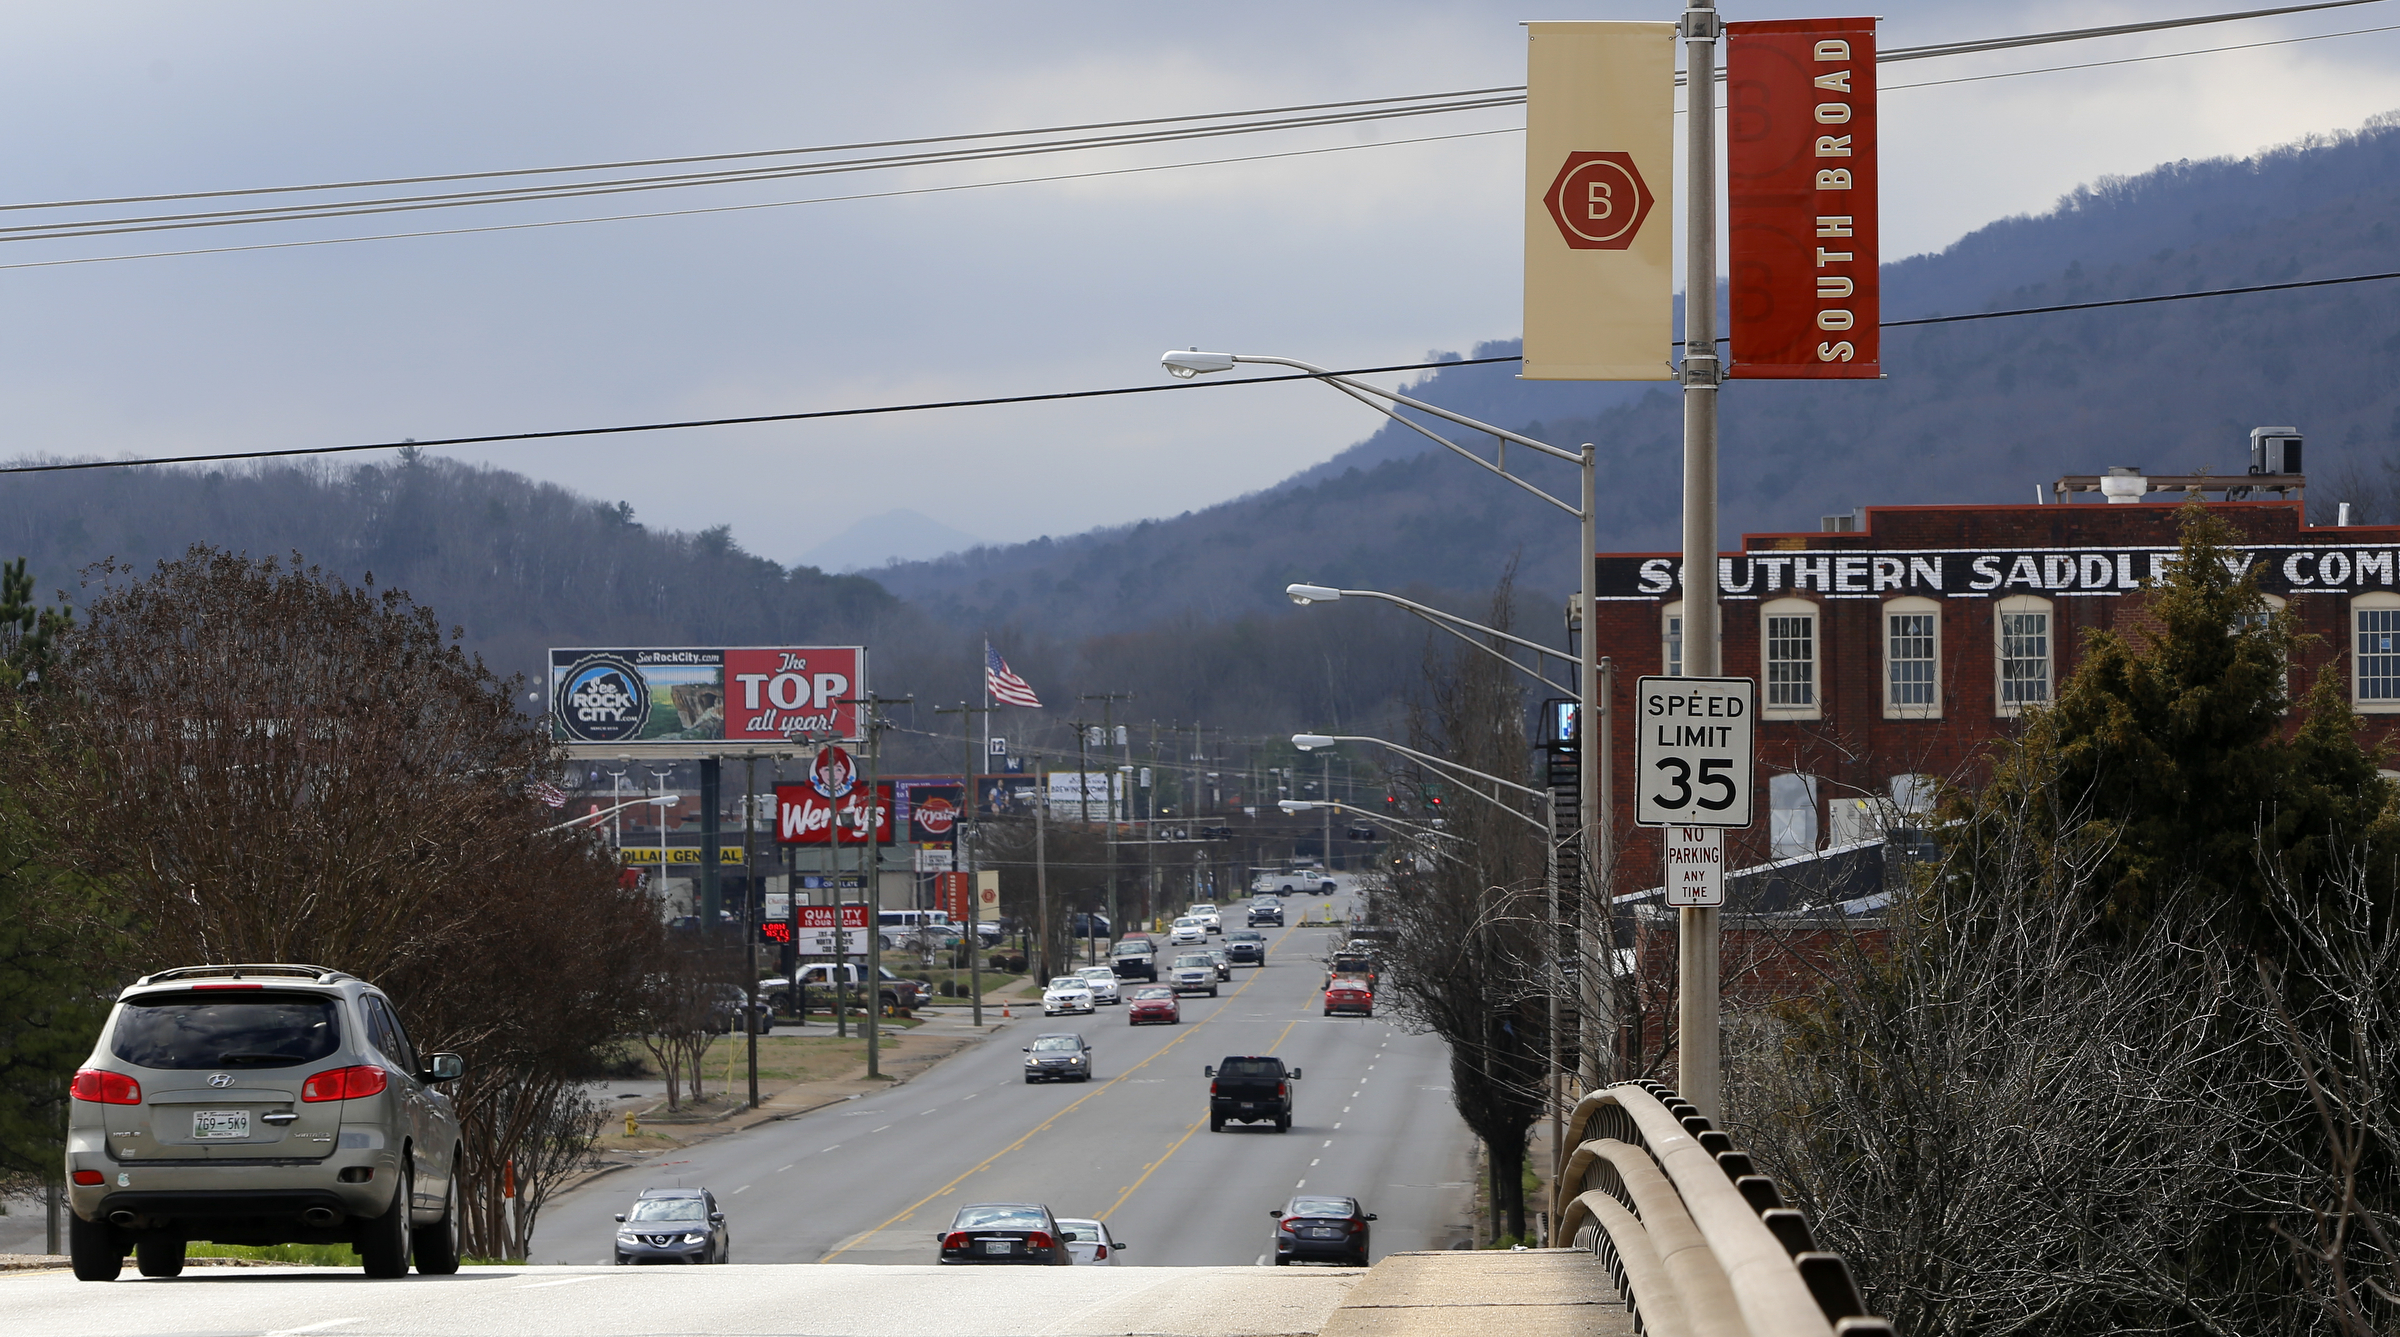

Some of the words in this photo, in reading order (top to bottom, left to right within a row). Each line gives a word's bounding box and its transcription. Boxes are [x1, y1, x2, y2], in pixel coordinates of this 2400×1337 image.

[1813, 38, 1852, 191] BROAD
[1587, 181, 1613, 220] B
[1815, 215, 1854, 363] SOUTH
[1637, 555, 1943, 594] SUTHERN
[1969, 551, 2256, 591] SADDLEY
[2282, 550, 2400, 587] COM
[775, 652, 807, 673] The
[587, 676, 618, 695] See
[735, 672, 849, 711] TOP
[573, 693, 632, 708] ROCK
[1648, 694, 1744, 718] SPEED
[745, 708, 778, 732] all
[778, 708, 838, 738] year!
[1658, 725, 1732, 748] LIMIT
[1652, 757, 1737, 811] 35
[1683, 827, 1704, 843] NO
[621, 850, 669, 862] OLLAR
[673, 850, 740, 862] GENAL
[1669, 847, 1719, 864] PARKING
[1684, 870, 1706, 882] ANY
[1682, 886, 1708, 898] TIME
